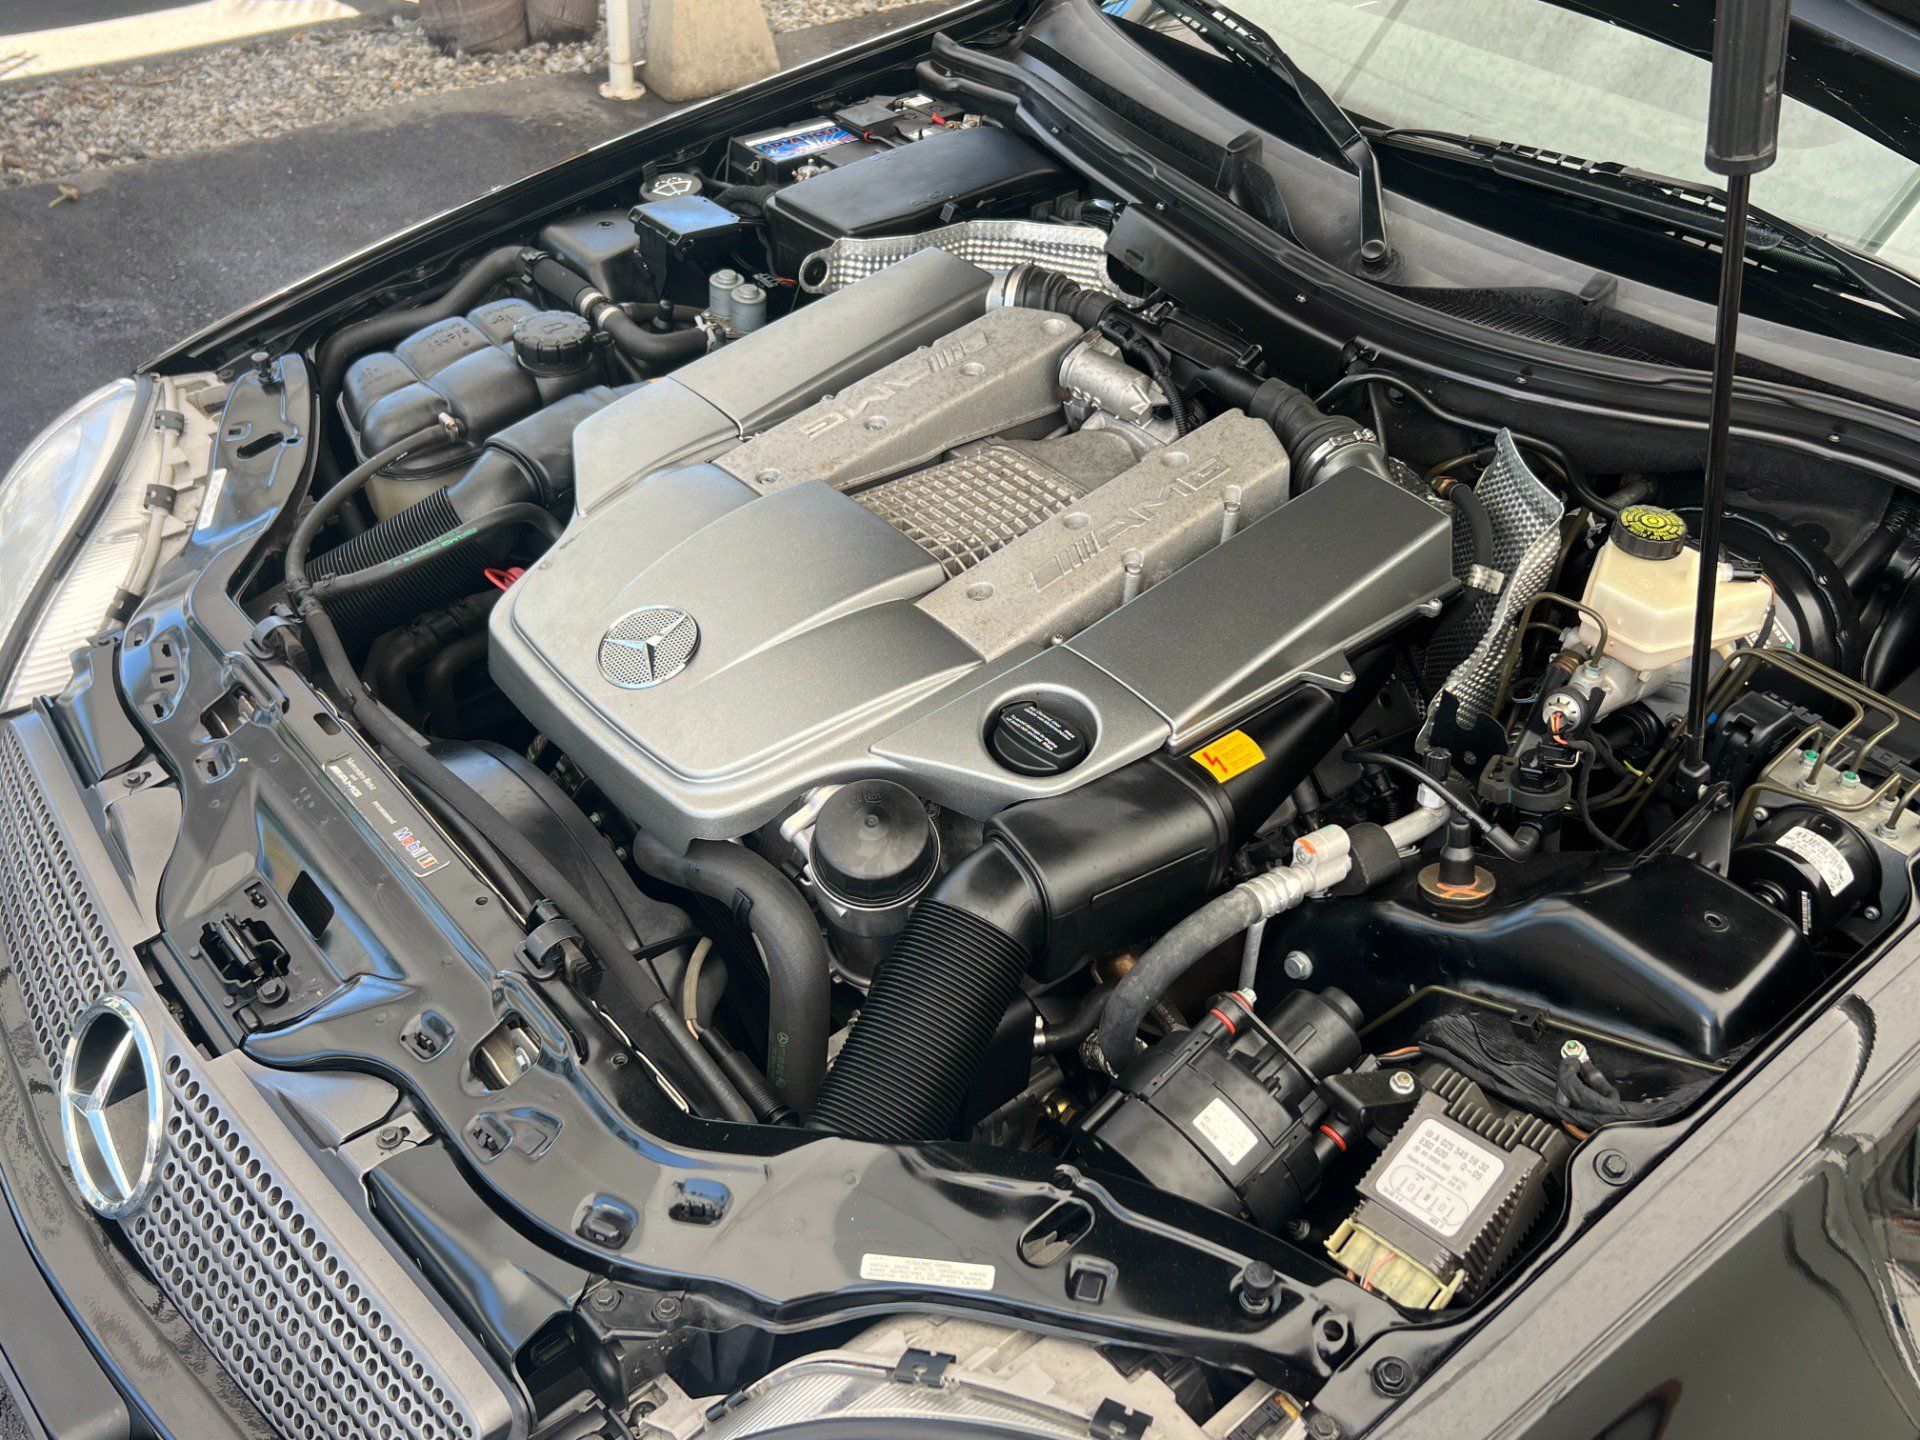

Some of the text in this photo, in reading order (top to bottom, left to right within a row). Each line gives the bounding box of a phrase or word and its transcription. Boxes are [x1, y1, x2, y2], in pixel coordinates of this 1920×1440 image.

[760, 127, 843, 150] ADVANCED
[345, 756, 377, 792] Mercedes-Benz
[393, 824, 428, 858] Mobil
